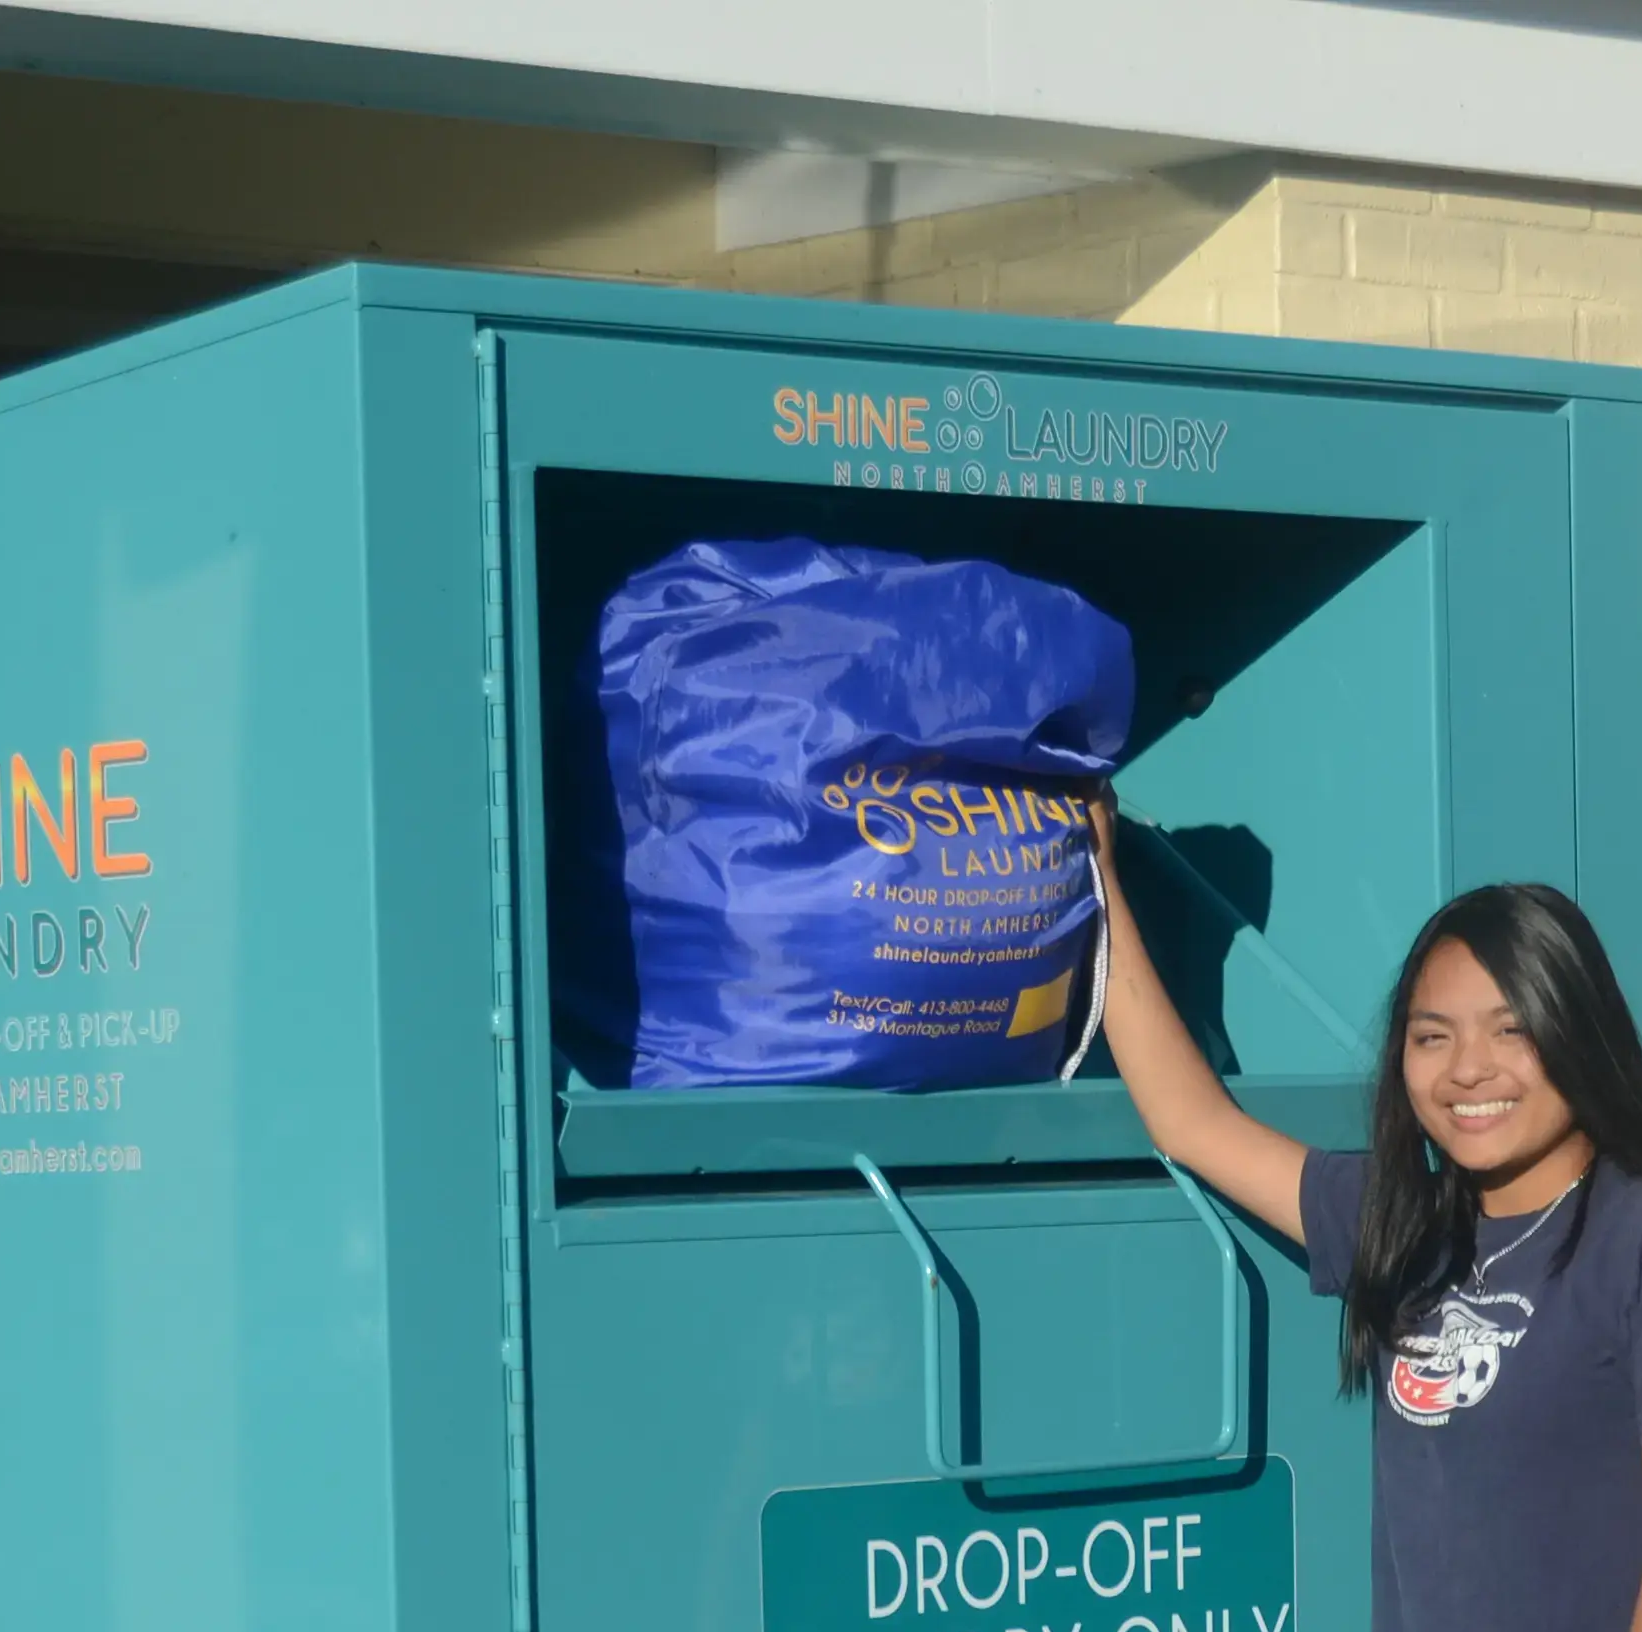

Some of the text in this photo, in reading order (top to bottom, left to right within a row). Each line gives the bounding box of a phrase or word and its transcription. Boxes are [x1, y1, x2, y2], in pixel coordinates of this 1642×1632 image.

[772, 386, 1228, 473] SHINE LAUNDRY
[833, 460, 1147, 504] NORTH AMHERST
[852, 880, 876, 899] 24
[885, 885, 938, 906] HOUR
[944, 887, 1024, 907] DROP-OFF
[894, 914, 971, 936] NORTH
[833, 989, 915, 1016] Text/Call:
[58, 1013, 74, 1050] &
[80, 1007, 180, 1048] PICK-UP
[879, 1019, 960, 1038] Montague
[963, 1018, 1001, 1034] Road
[866, 1513, 1202, 1619] DROP-OFF
